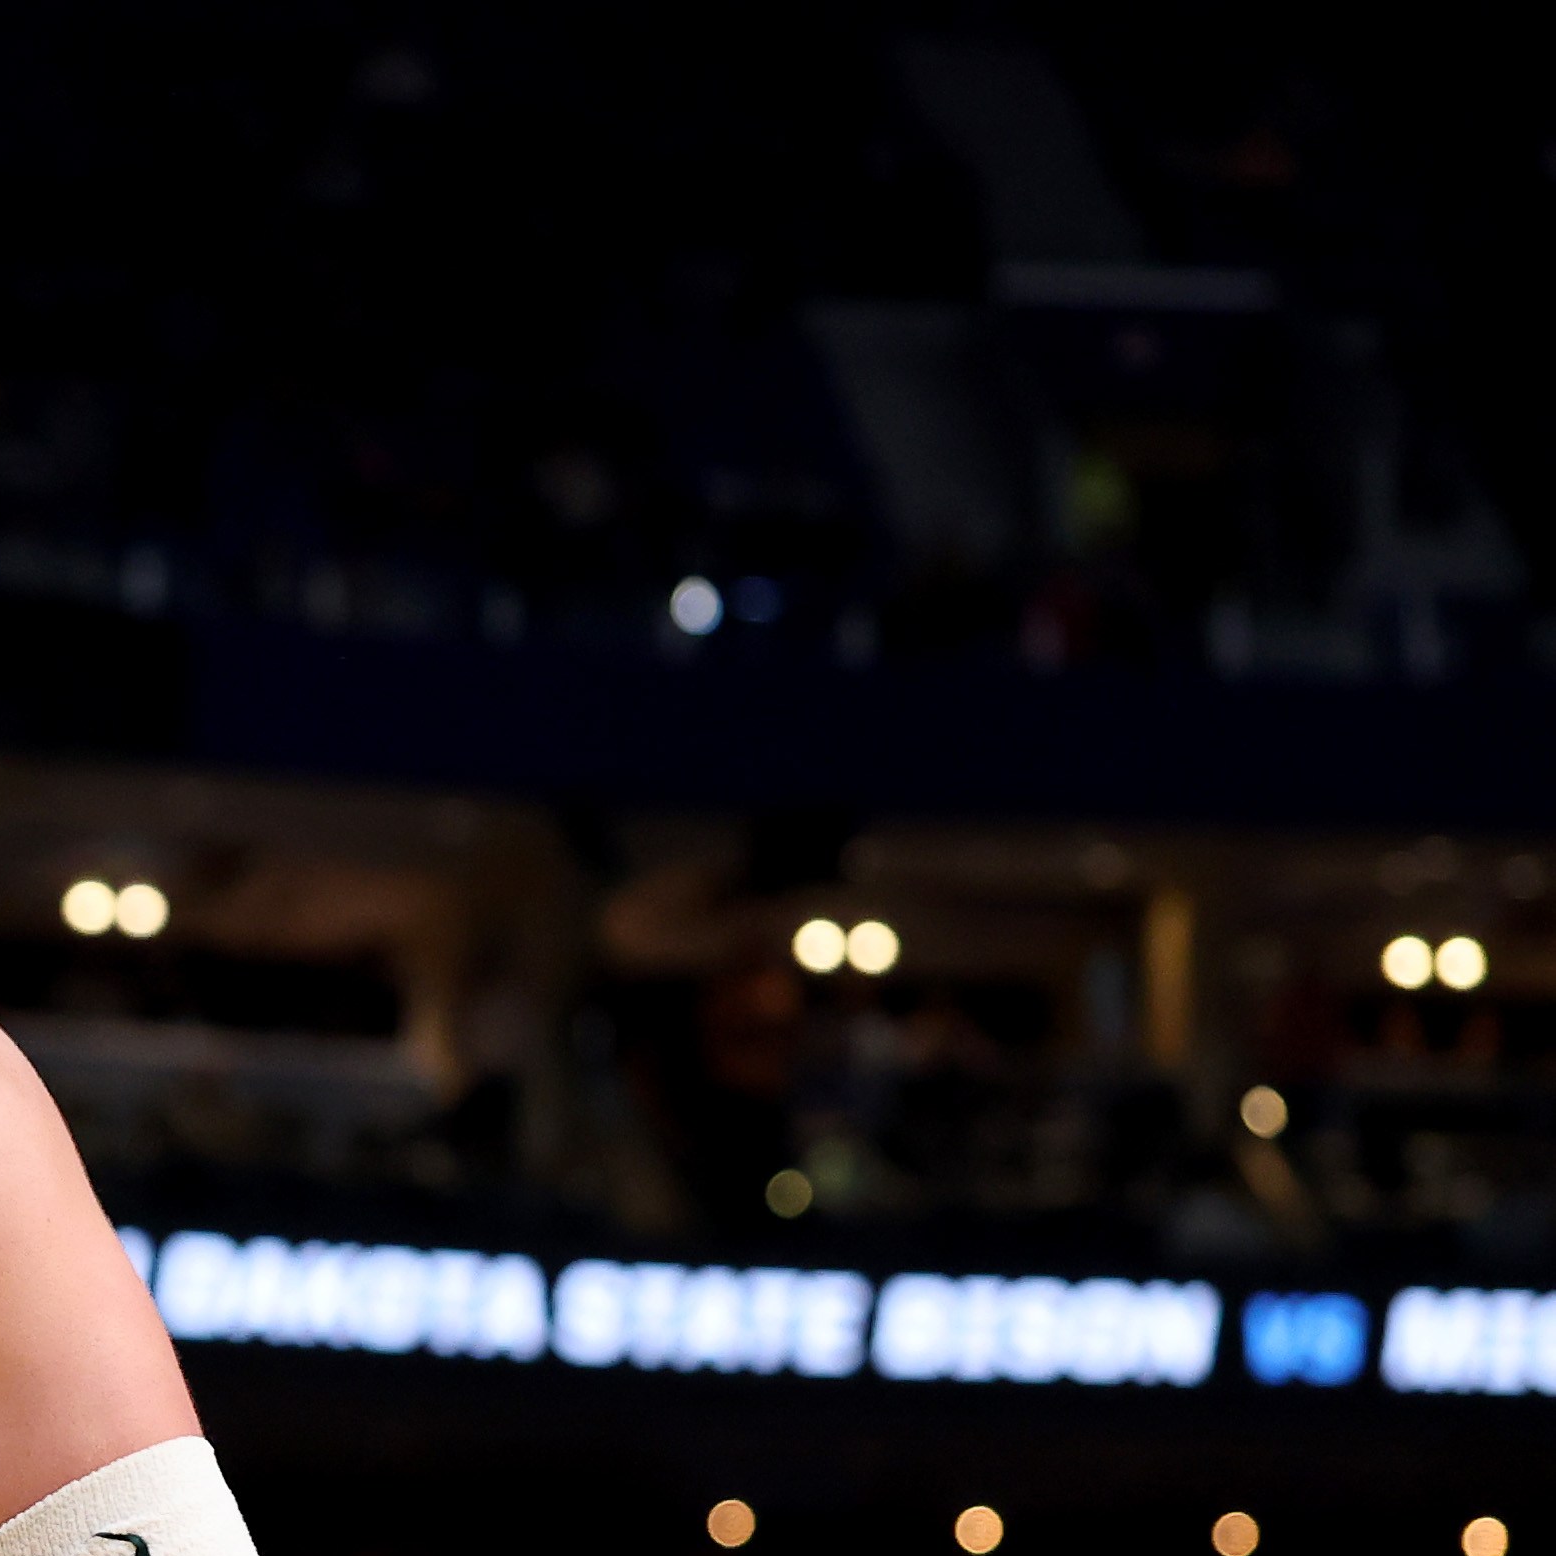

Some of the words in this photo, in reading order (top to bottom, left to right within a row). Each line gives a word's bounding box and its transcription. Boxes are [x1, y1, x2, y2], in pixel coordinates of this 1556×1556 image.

[155, 1231, 551, 1360] DAKOTA
[551, 1260, 871, 1377] STATE
[870, 1274, 1221, 1386] BISON
[1381, 1287, 1556, 1395] MI
